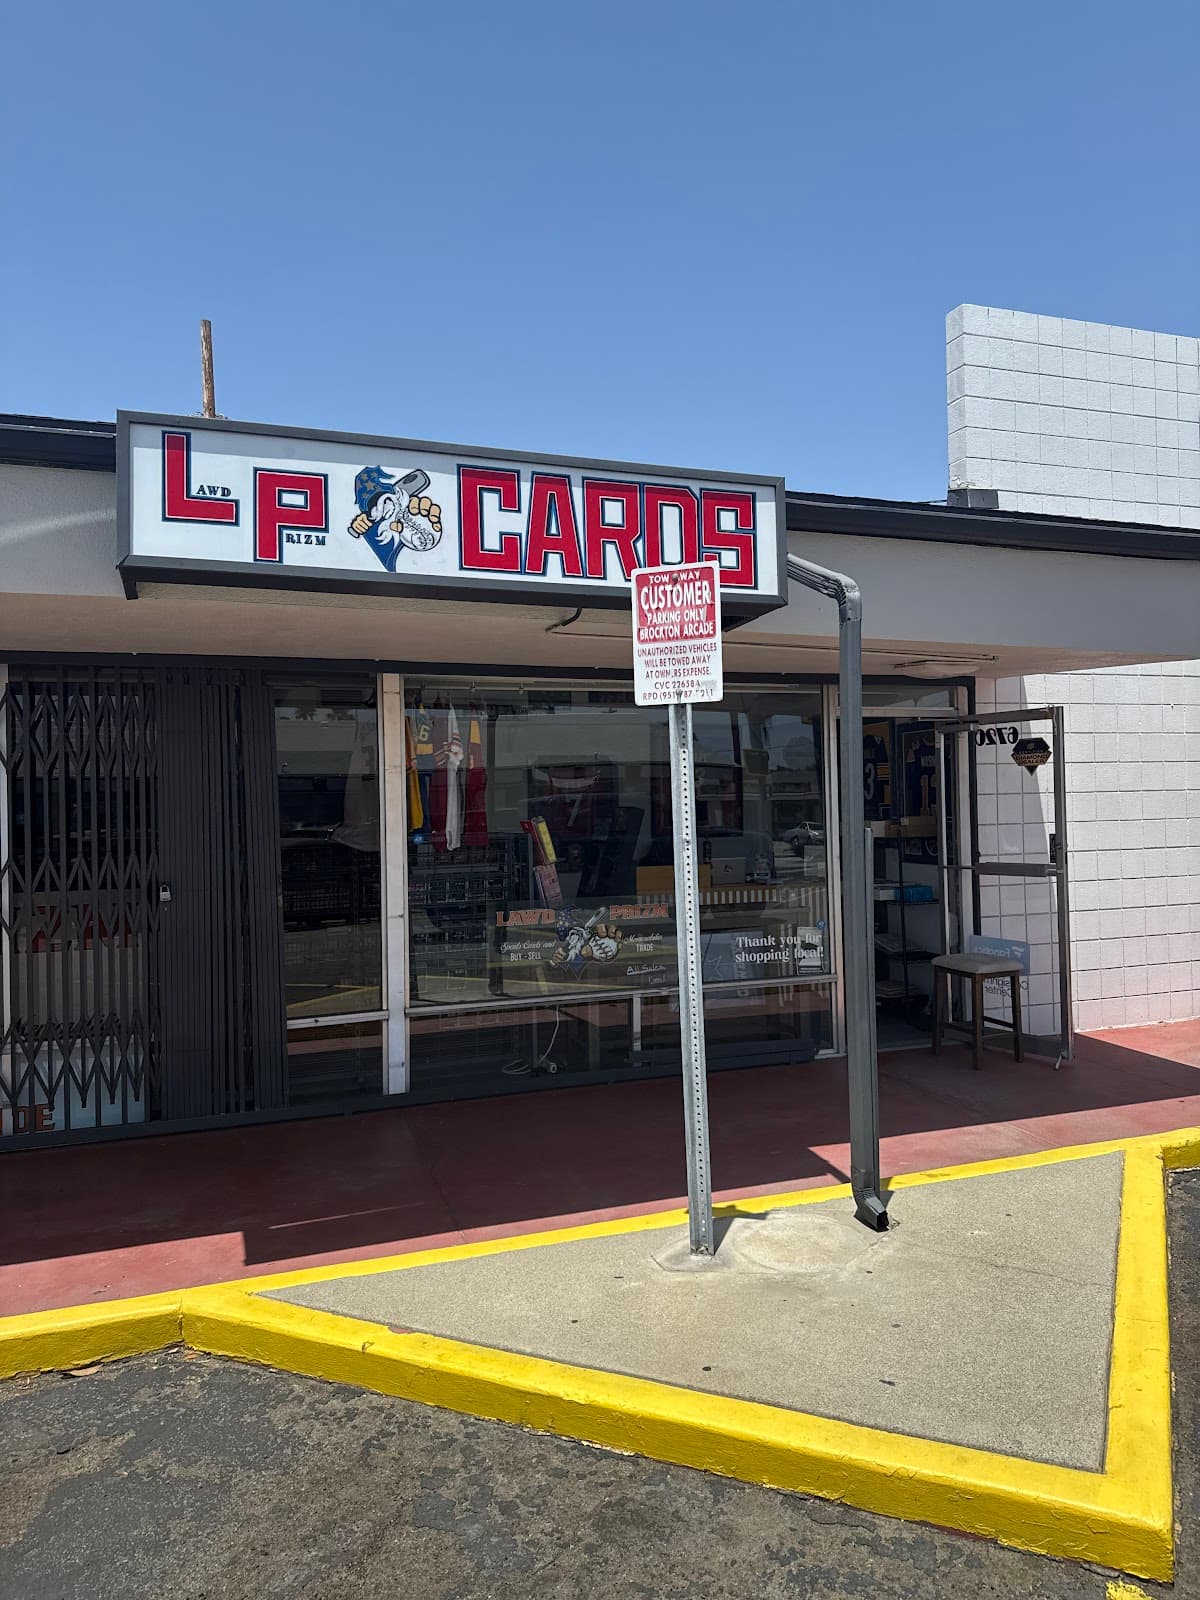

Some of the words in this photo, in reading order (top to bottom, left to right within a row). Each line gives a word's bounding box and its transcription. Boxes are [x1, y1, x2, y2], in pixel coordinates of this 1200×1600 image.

[457, 464, 757, 589] CARDS
[649, 573, 669, 584] TOW
[672, 571, 700, 581] WAY
[640, 580, 712, 610] CUSTOMER
[647, 610, 681, 625] PARKING
[684, 608, 705, 622] ONLY
[640, 625, 680, 640] BROCKTON
[683, 622, 714, 637] ARCADE
[638, 645, 687, 657] UNAUTHORIZED
[688, 642, 717, 654] VEHICLES
[644, 658, 658, 668] WILL
[659, 658, 667, 667] BE
[668, 656, 690, 667] TOWED
[691, 654, 711, 665] AWAY
[645, 670, 654, 679] AT
[655, 667, 682, 678] OWNRS
[654, 681, 670, 690] CVC
[643, 692, 658, 701] RPD
[496, 908, 556, 927] LAWD
[609, 903, 669, 920] PRIZM
[735, 935, 776, 948] Thank
[780, 935, 801, 947] you
[805, 932, 822, 944] for
[510, 952, 523, 961] BUY
[528, 951, 542, 960] SELL
[735, 947, 790, 964] shopping
[794, 946, 825, 959] local!
